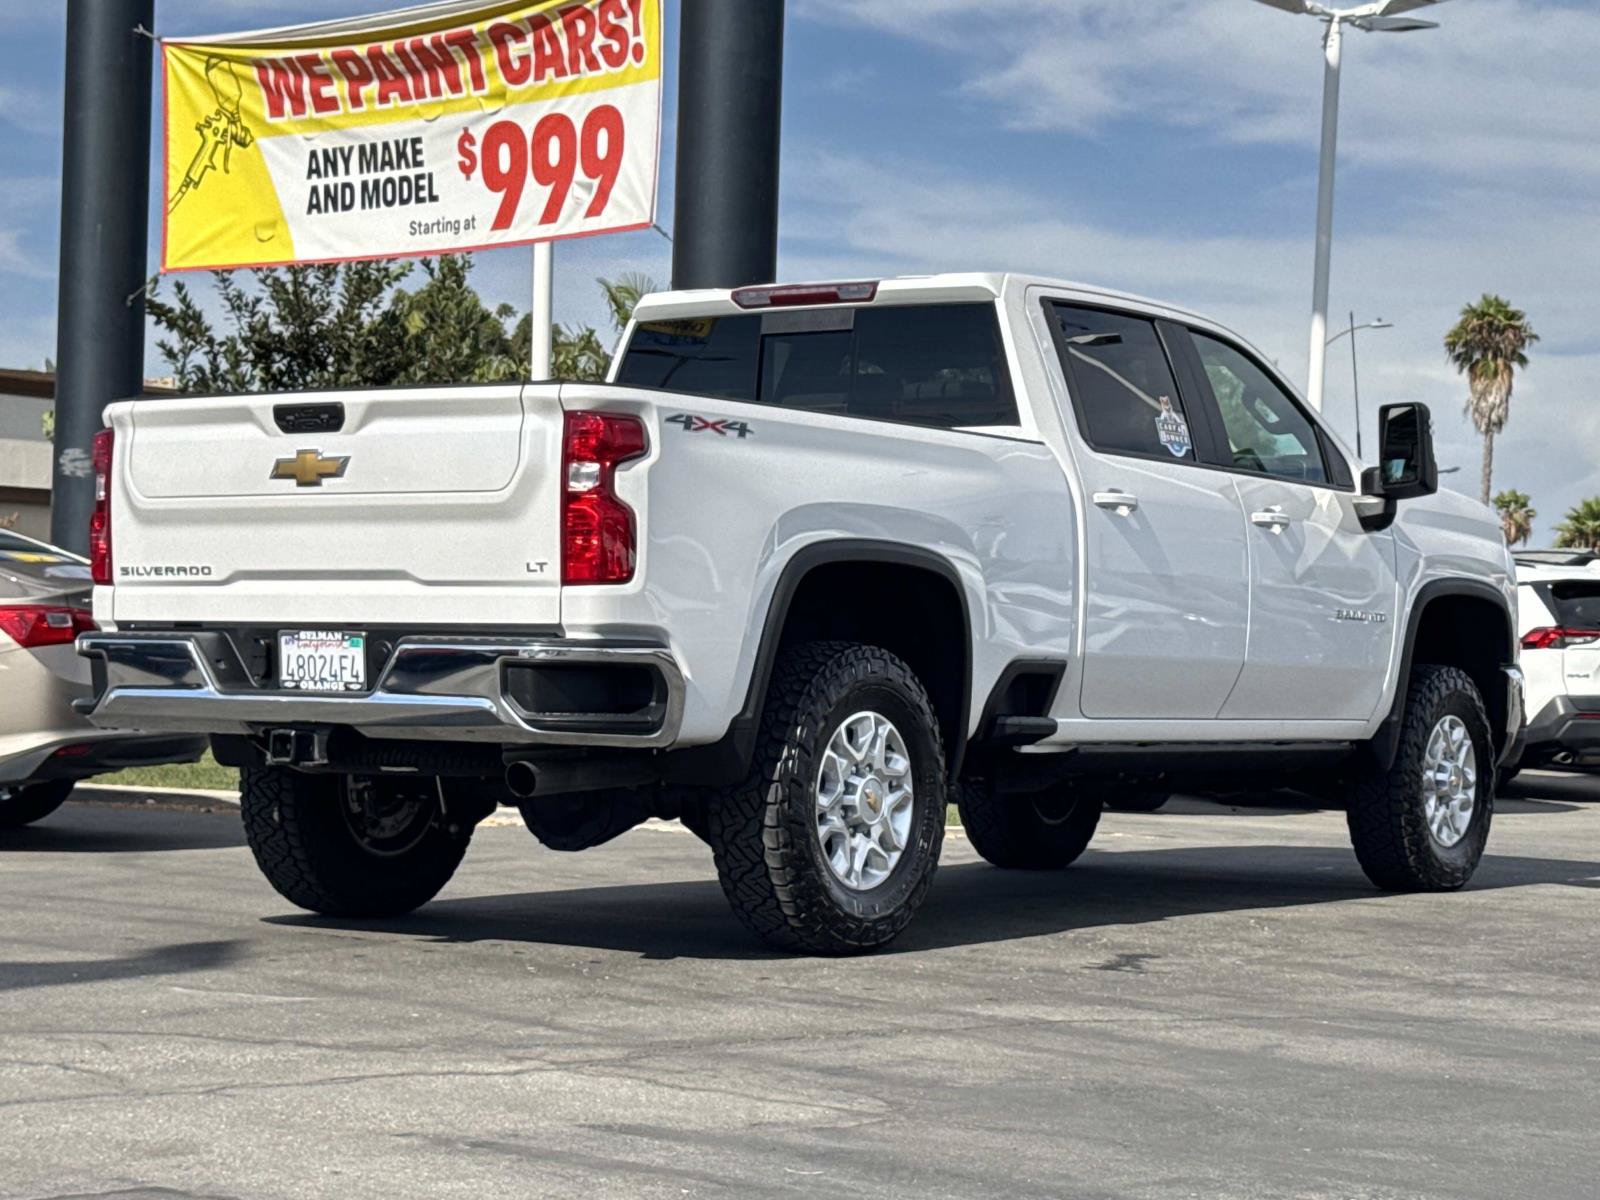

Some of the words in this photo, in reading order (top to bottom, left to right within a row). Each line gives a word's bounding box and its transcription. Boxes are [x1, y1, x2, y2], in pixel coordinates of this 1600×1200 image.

[253, 53, 341, 118] WE
[331, 29, 487, 109] PAINT
[486, 0, 644, 86] CARS!
[306, 145, 355, 180] ANY
[358, 136, 425, 175] MAKE
[306, 181, 356, 215] AND
[360, 172, 440, 211] MODEL
[409, 216, 461, 236] Starting
[463, 215, 477, 231] at
[119, 565, 213, 577] SILVERADO
[526, 561, 548, 573] LT
[286, 653, 360, 682] 48024F4
[299, 680, 345, 690] ORANGE
